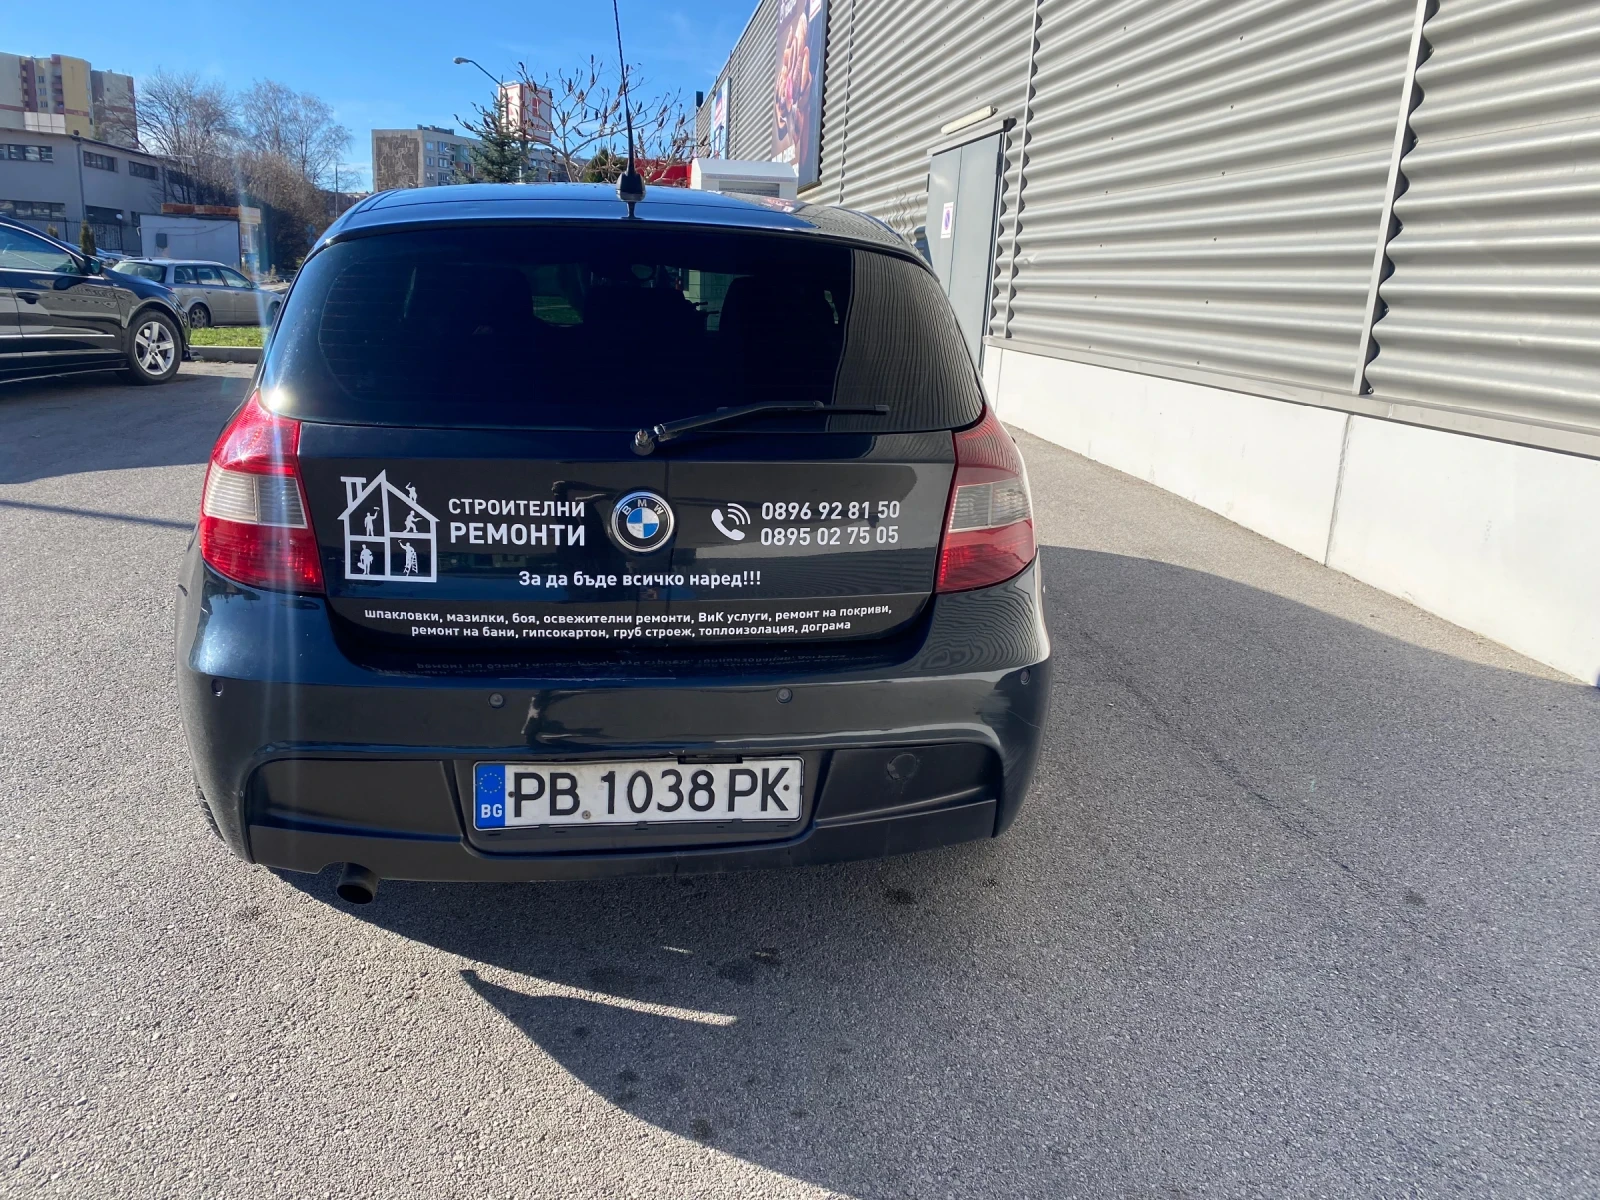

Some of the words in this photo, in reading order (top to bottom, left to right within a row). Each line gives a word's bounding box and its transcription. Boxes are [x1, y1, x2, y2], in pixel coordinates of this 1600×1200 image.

[448, 498, 586, 518] СТРОИТЕЛНИ
[621, 499, 664, 516] BMW
[761, 502, 812, 520] 0896
[818, 502, 842, 520] 92
[847, 501, 871, 519] 81
[877, 500, 900, 519] 50
[449, 521, 586, 547] РЕМОНТИ
[760, 527, 811, 546] 0895
[816, 527, 841, 545] 02
[847, 526, 870, 545] 75
[875, 526, 899, 544] 05
[518, 571, 541, 586] За
[545, 575, 568, 588] да
[573, 571, 617, 588] бъде
[622, 574, 684, 586] всичко
[689, 571, 761, 588] наред!!!
[364, 609, 443, 623] шпакловки,
[446, 612, 509, 625] мазилки,
[512, 613, 540, 625] боя,
[543, 614, 632, 624] освежителни
[636, 613, 695, 625] ремонти,
[698, 612, 724, 622] ВиК
[727, 611, 772, 623] услуги,
[775, 610, 819, 622] ремонт
[822, 608, 837, 617] на
[839, 605, 892, 616] покриви,
[411, 625, 460, 637] ремонт
[463, 627, 479, 637] на
[482, 626, 519, 639] бани,
[522, 628, 610, 640] гипсокартон,
[613, 627, 642, 640] груб
[645, 627, 696, 639] строеж,
[699, 625, 799, 637] топлоизолация,
[800, 620, 851, 634] дограма
[513, 772, 581, 818] PB
[600, 769, 716, 815] 1038
[727, 767, 790, 812] PK
[481, 804, 503, 818] BG
